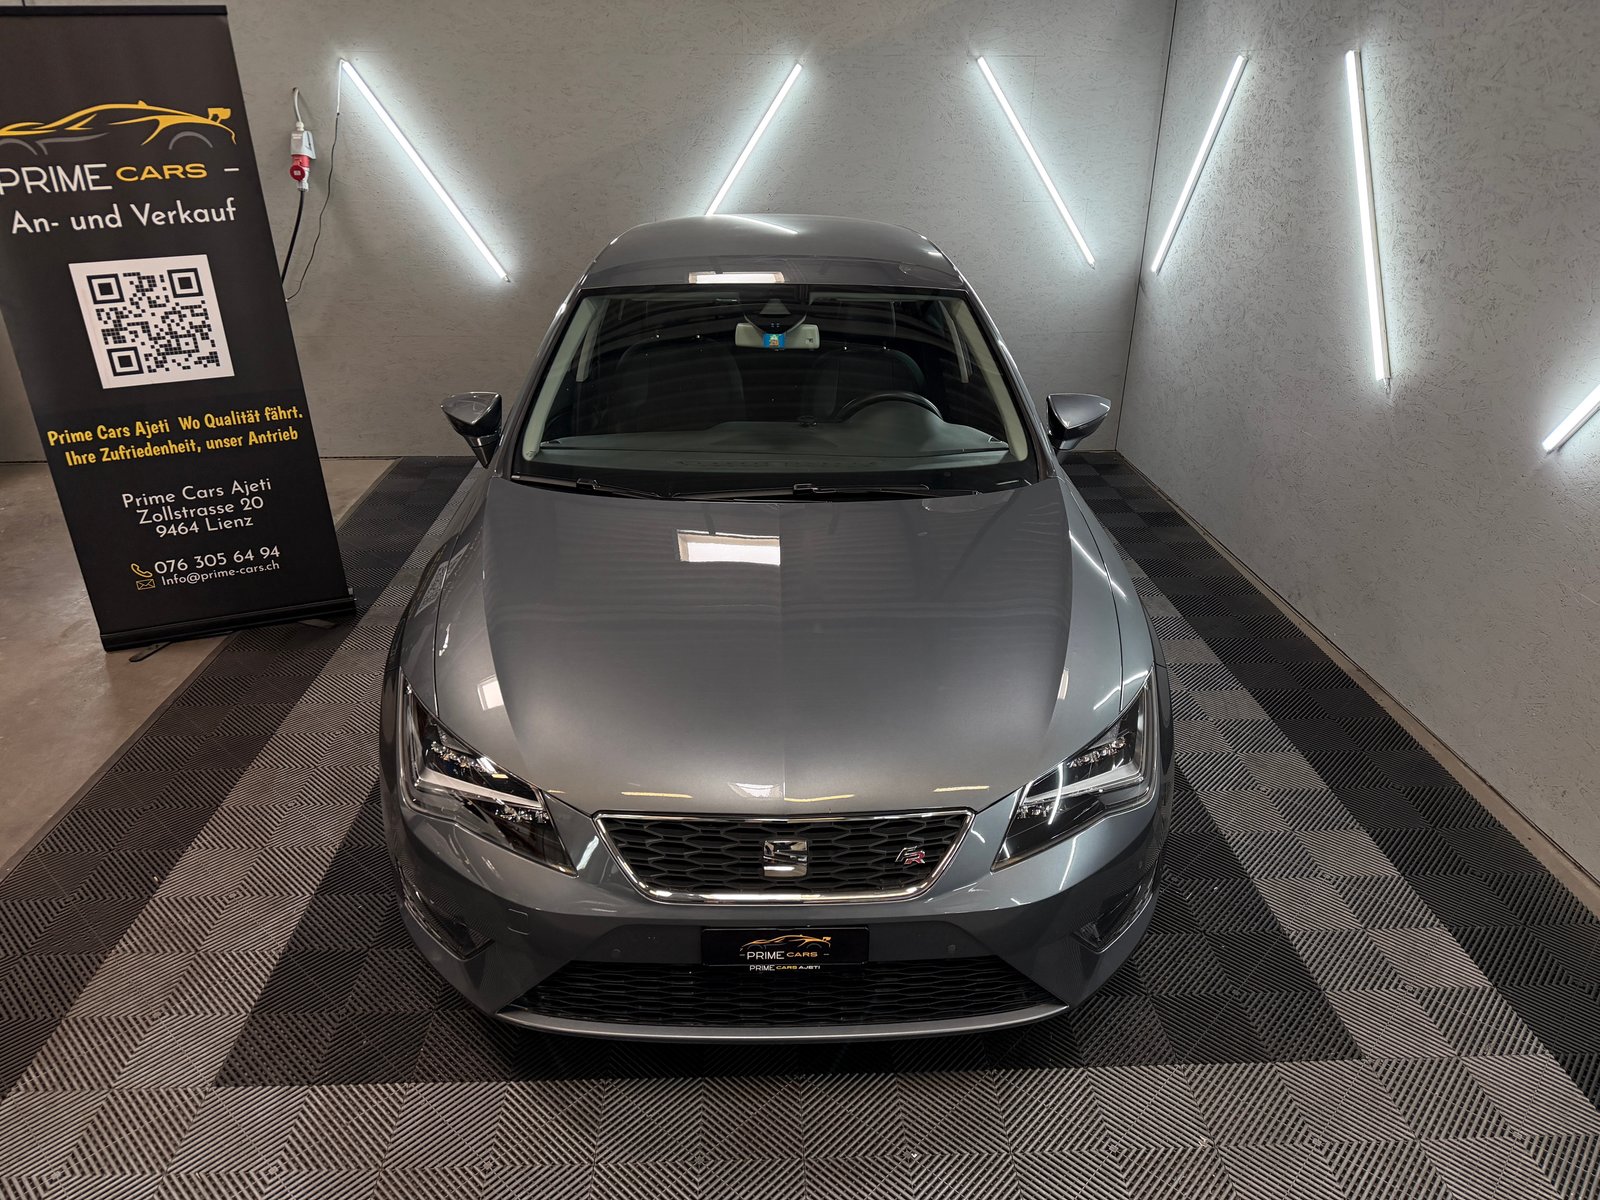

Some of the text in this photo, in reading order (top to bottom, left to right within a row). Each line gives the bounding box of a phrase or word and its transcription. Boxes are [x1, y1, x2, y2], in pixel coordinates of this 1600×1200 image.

[0, 163, 208, 195] PRIME CARS
[11, 197, 237, 235] An- und Verkauf
[47, 405, 304, 447] Prime Cars Ajeti Wo Qualität fährt.
[64, 426, 299, 467] Ihre Zufriedenheit, unser Antrieb
[122, 477, 272, 508] Prime Cars Ajeti
[137, 496, 264, 524] Zollstrasse 20
[155, 515, 254, 538] 9464 Lienz
[154, 545, 281, 575] 076 305 64 94
[161, 560, 280, 586] Info@prime-cars.ch
[747, 950, 785, 960] PRIME
